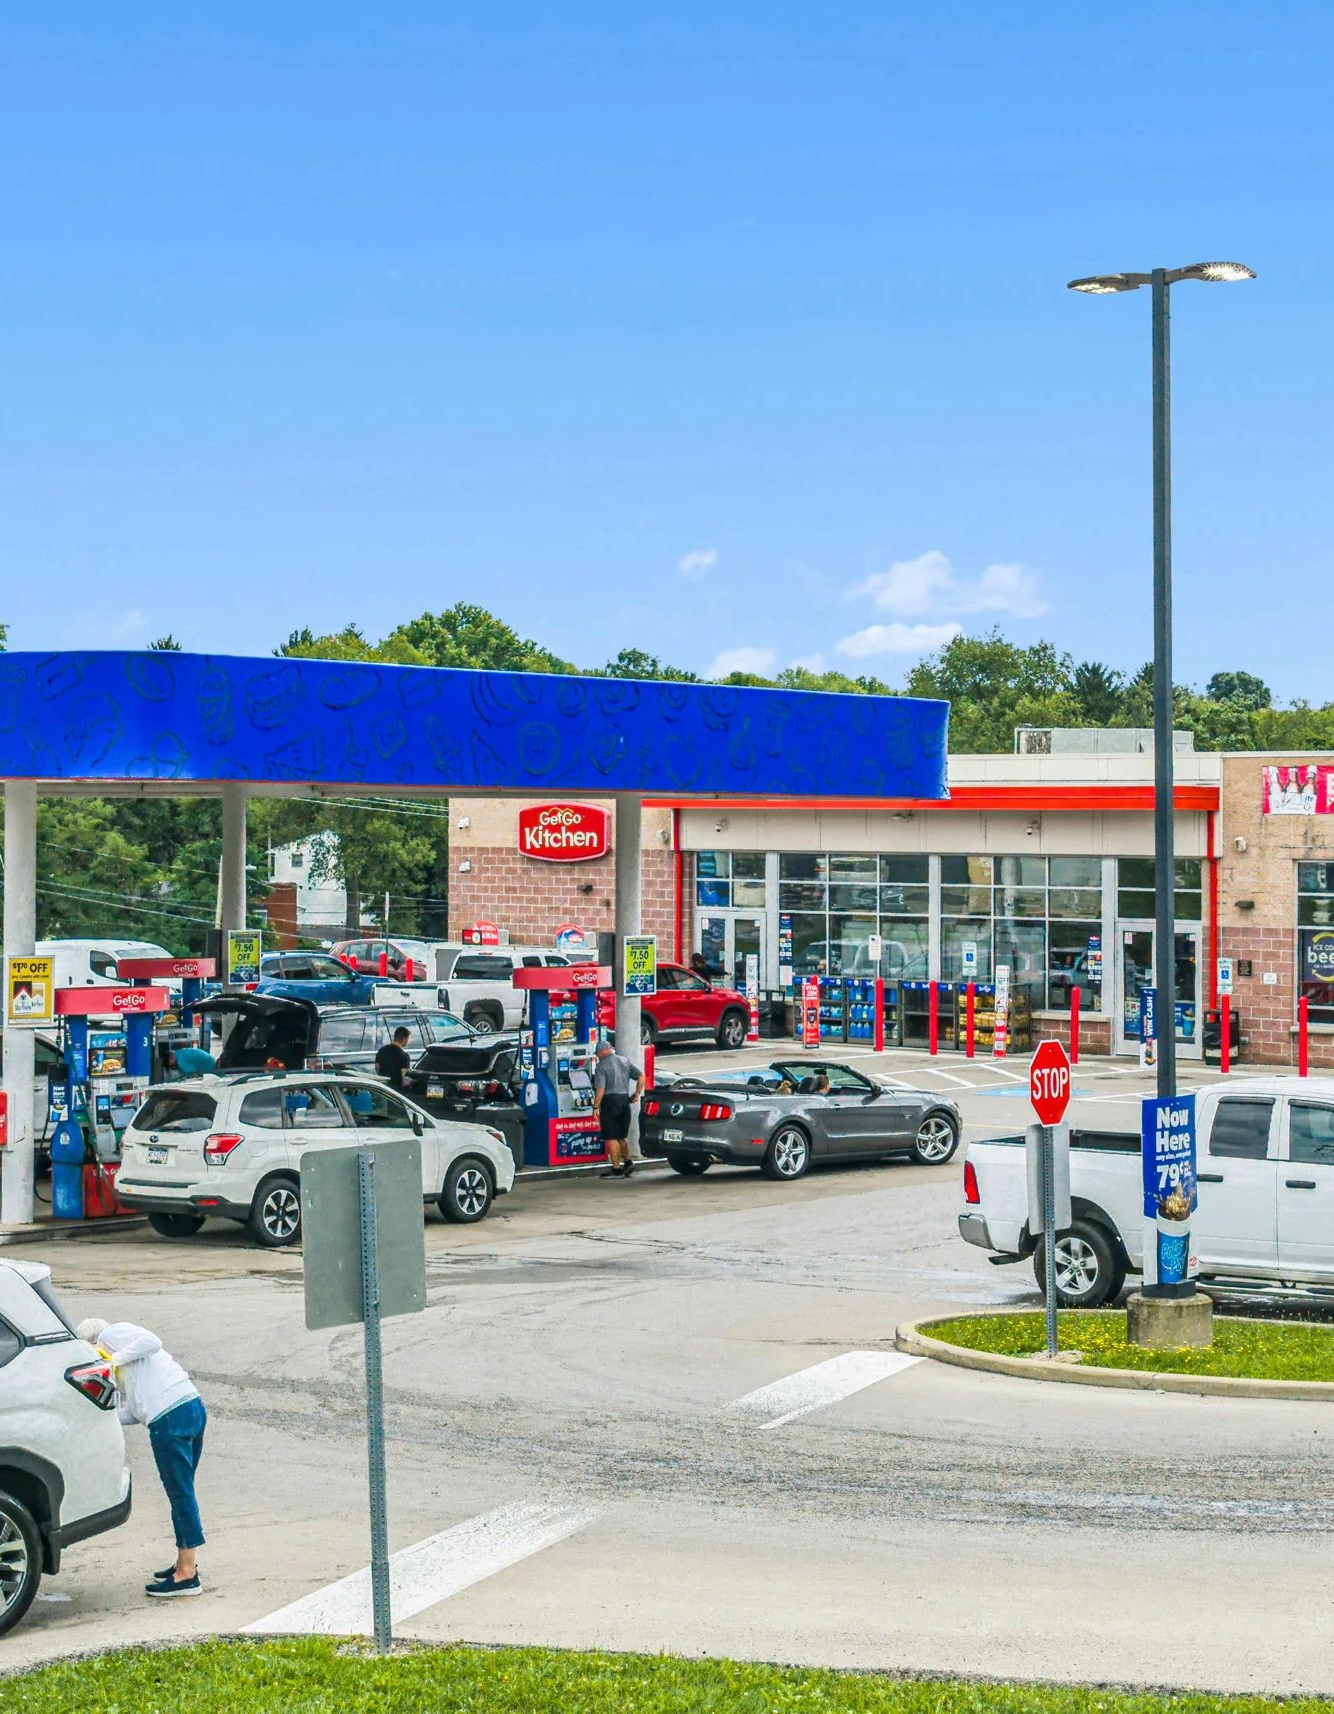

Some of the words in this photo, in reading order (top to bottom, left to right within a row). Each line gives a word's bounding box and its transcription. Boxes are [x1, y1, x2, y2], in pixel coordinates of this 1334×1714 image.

[539, 811, 581, 825] GetGo
[524, 825, 598, 850] Kitchen
[237, 953, 251, 961] OFF
[30, 963, 48, 973] OFF
[173, 964, 198, 973] GetGo
[632, 961, 646, 969] OFF
[573, 973, 598, 983] GetGo
[113, 994, 145, 1006] GetGo
[143, 1037, 149, 1047] 3
[1033, 1067, 1068, 1100] STOP
[1157, 1106, 1189, 1129] Now
[555, 1123, 564, 1131] Get
[571, 1138, 585, 1150] pump
[586, 1136, 593, 1144] up
[1156, 1130, 1190, 1153] Here
[1166, 1152, 1175, 1160] size,
[1161, 1240, 1184, 1260] Polar
